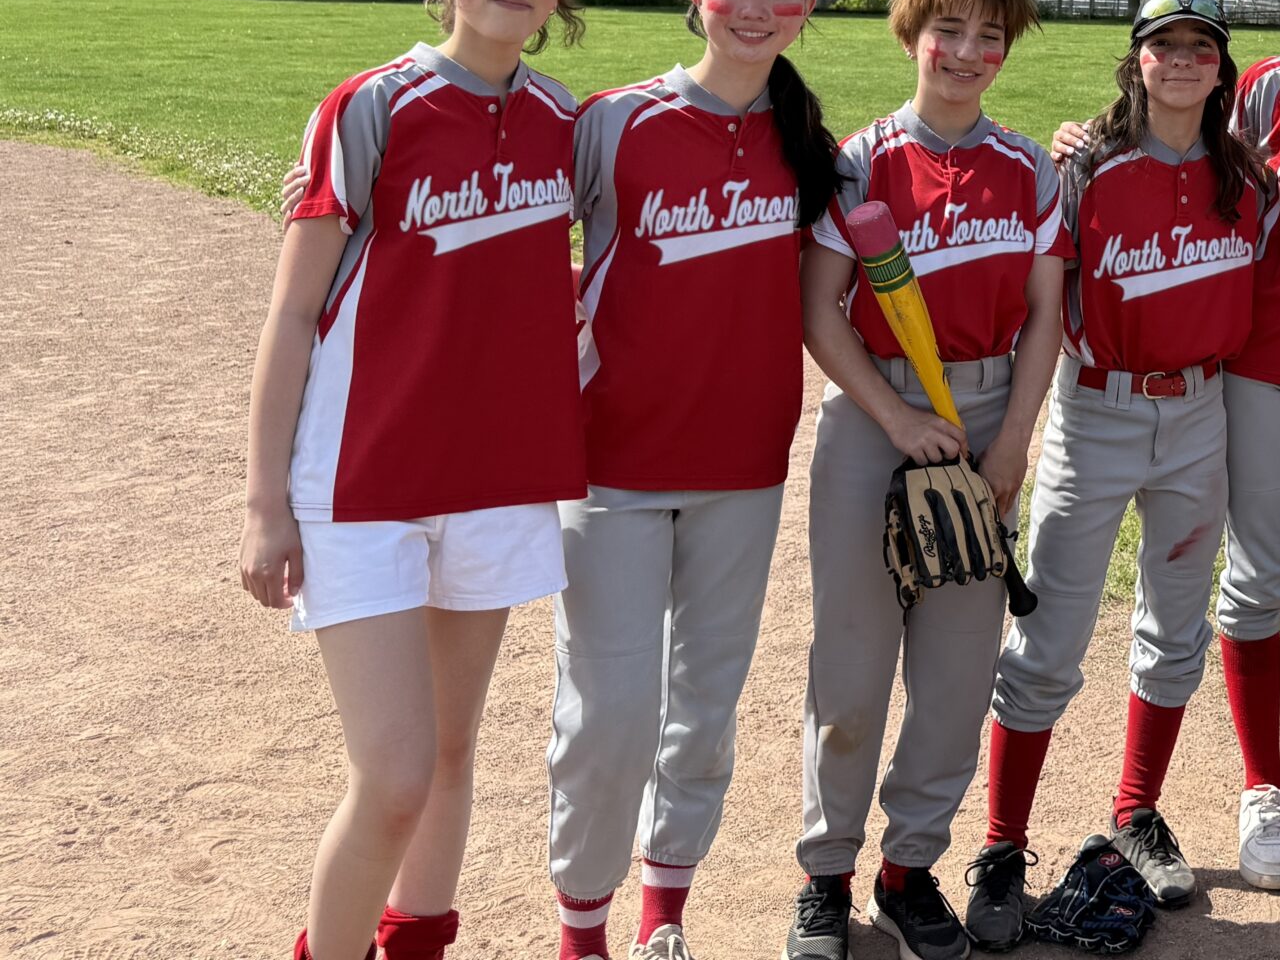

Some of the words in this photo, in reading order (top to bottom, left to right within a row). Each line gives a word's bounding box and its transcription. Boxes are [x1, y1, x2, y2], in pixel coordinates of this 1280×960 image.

[399, 171, 488, 232] North
[634, 188, 715, 238] North
[721, 178, 800, 227] Toront
[898, 211, 939, 253] rth
[946, 202, 1025, 246] Toronto
[1093, 232, 1166, 279] North
[1171, 223, 1247, 266] Toronto
